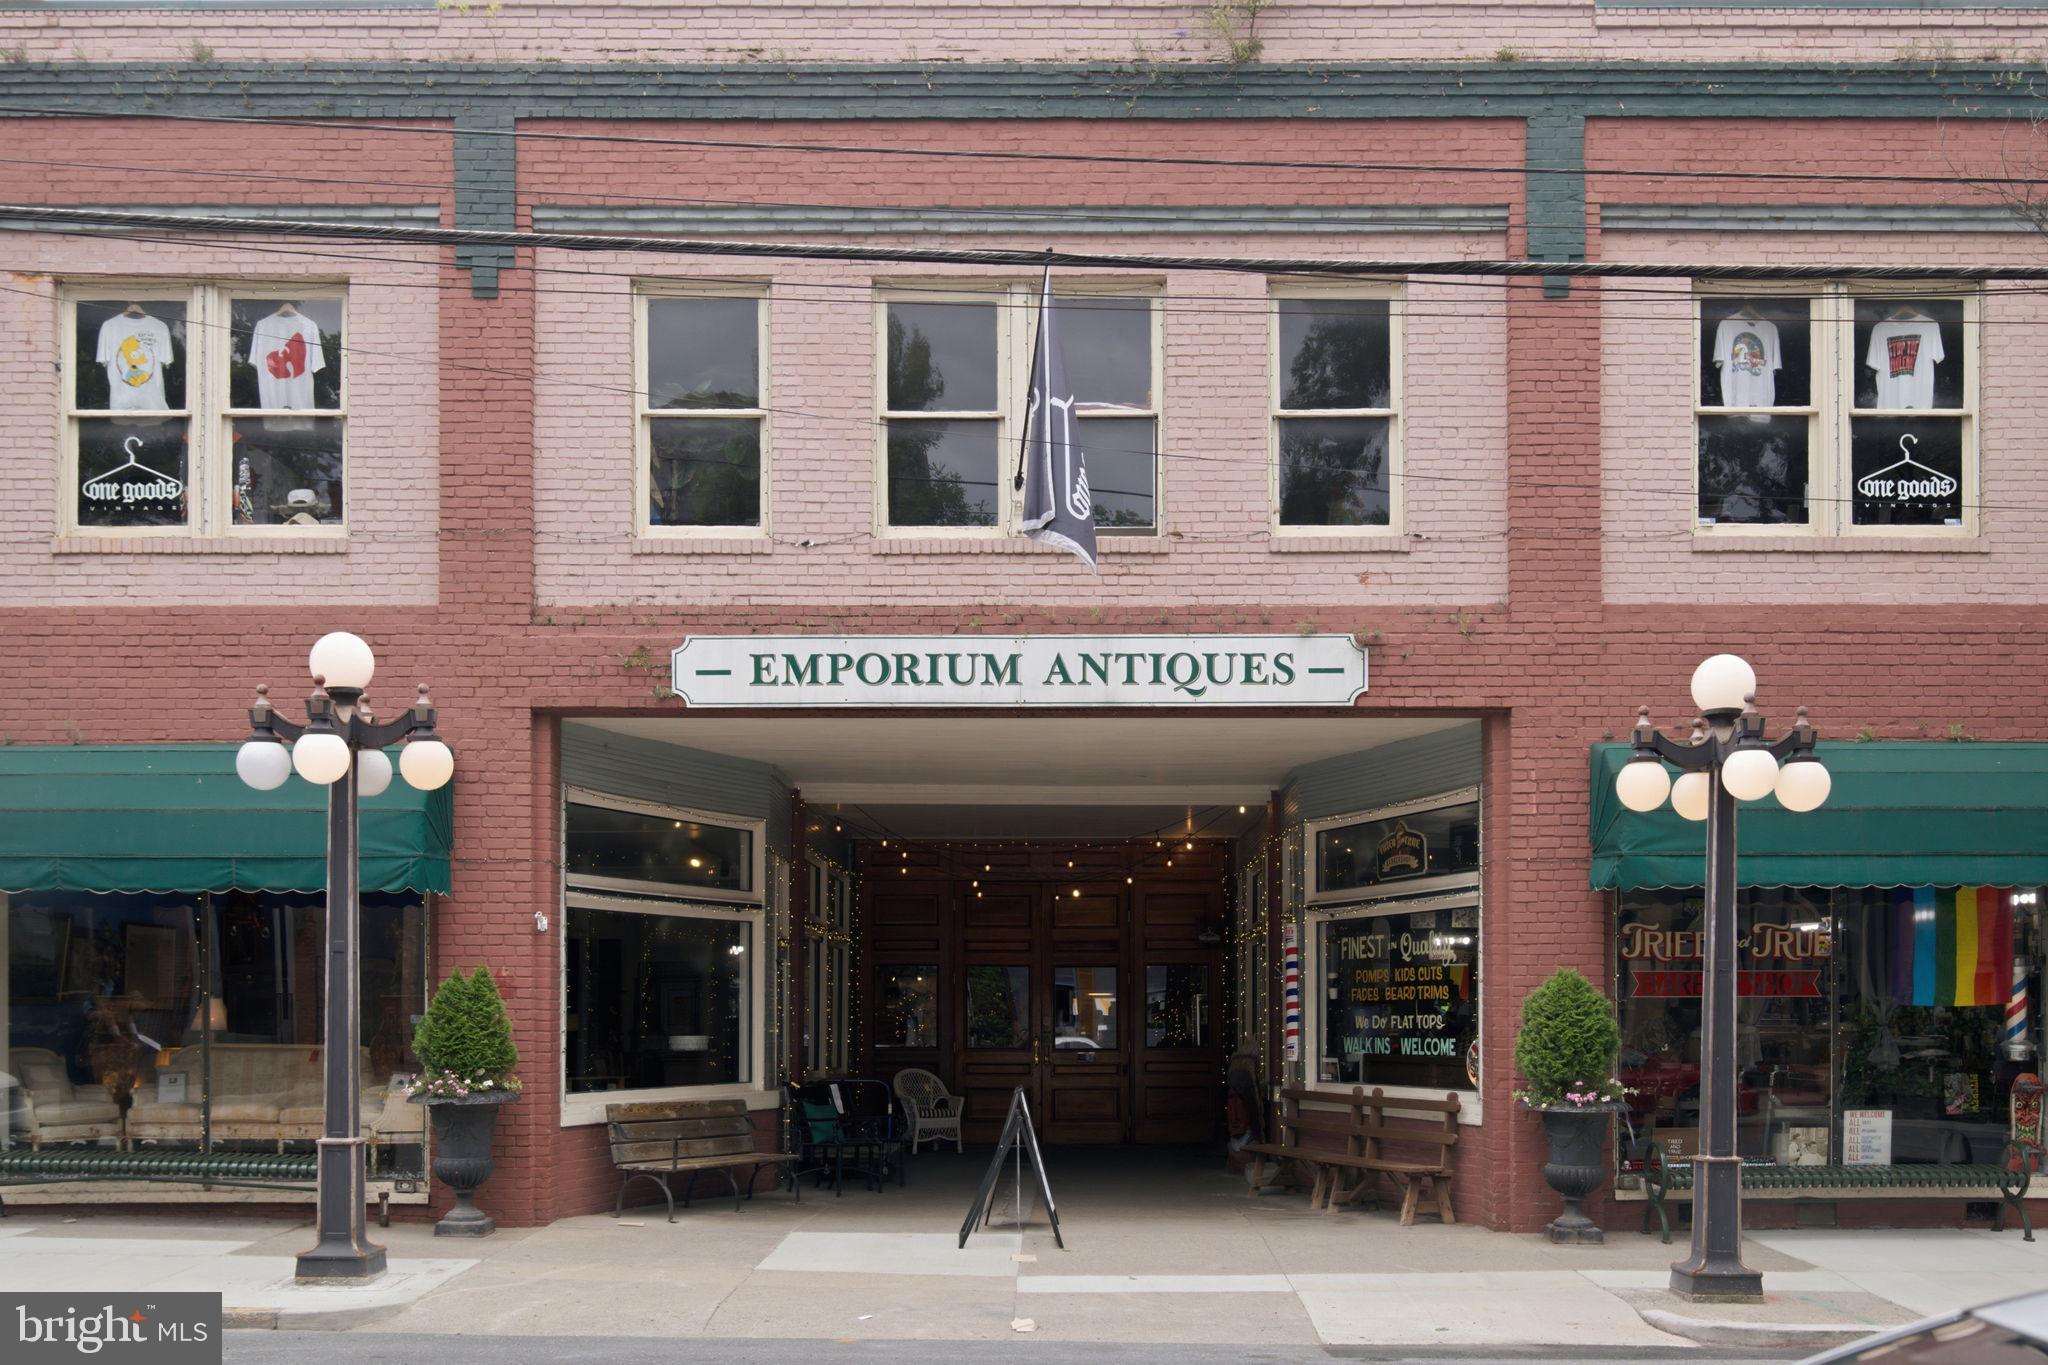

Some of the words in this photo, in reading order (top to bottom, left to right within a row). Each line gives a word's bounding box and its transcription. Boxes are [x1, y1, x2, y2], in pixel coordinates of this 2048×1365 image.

[89, 482, 120, 500] one
[123, 479, 176, 502] goods
[1864, 480, 1895, 497] one
[1898, 476, 1951, 500] goods
[749, 653, 1023, 686] EMPORIUM
[1042, 652, 1295, 697] ANTIQUES
[1341, 934, 1385, 960] FINEST
[1400, 930, 1457, 967] Quality
[1752, 922, 1831, 961] TRUE
[1355, 968, 1390, 983] POMPS
[1394, 967, 1416, 981] KIDS
[1418, 966, 1443, 980] CUTS
[1351, 987, 1379, 1002] FADES
[1385, 985, 1416, 1000] BEARD
[1418, 984, 1450, 1000] TRIMS
[1355, 1015, 1369, 1029] We
[1372, 1014, 1386, 1028] Do
[1391, 1014, 1414, 1029] FLAT
[1416, 1014, 1446, 1029] TOPS
[1343, 1037, 1372, 1054] WALK
[1374, 1037, 1391, 1054] INS
[1400, 1038, 1456, 1056] WELCOME
